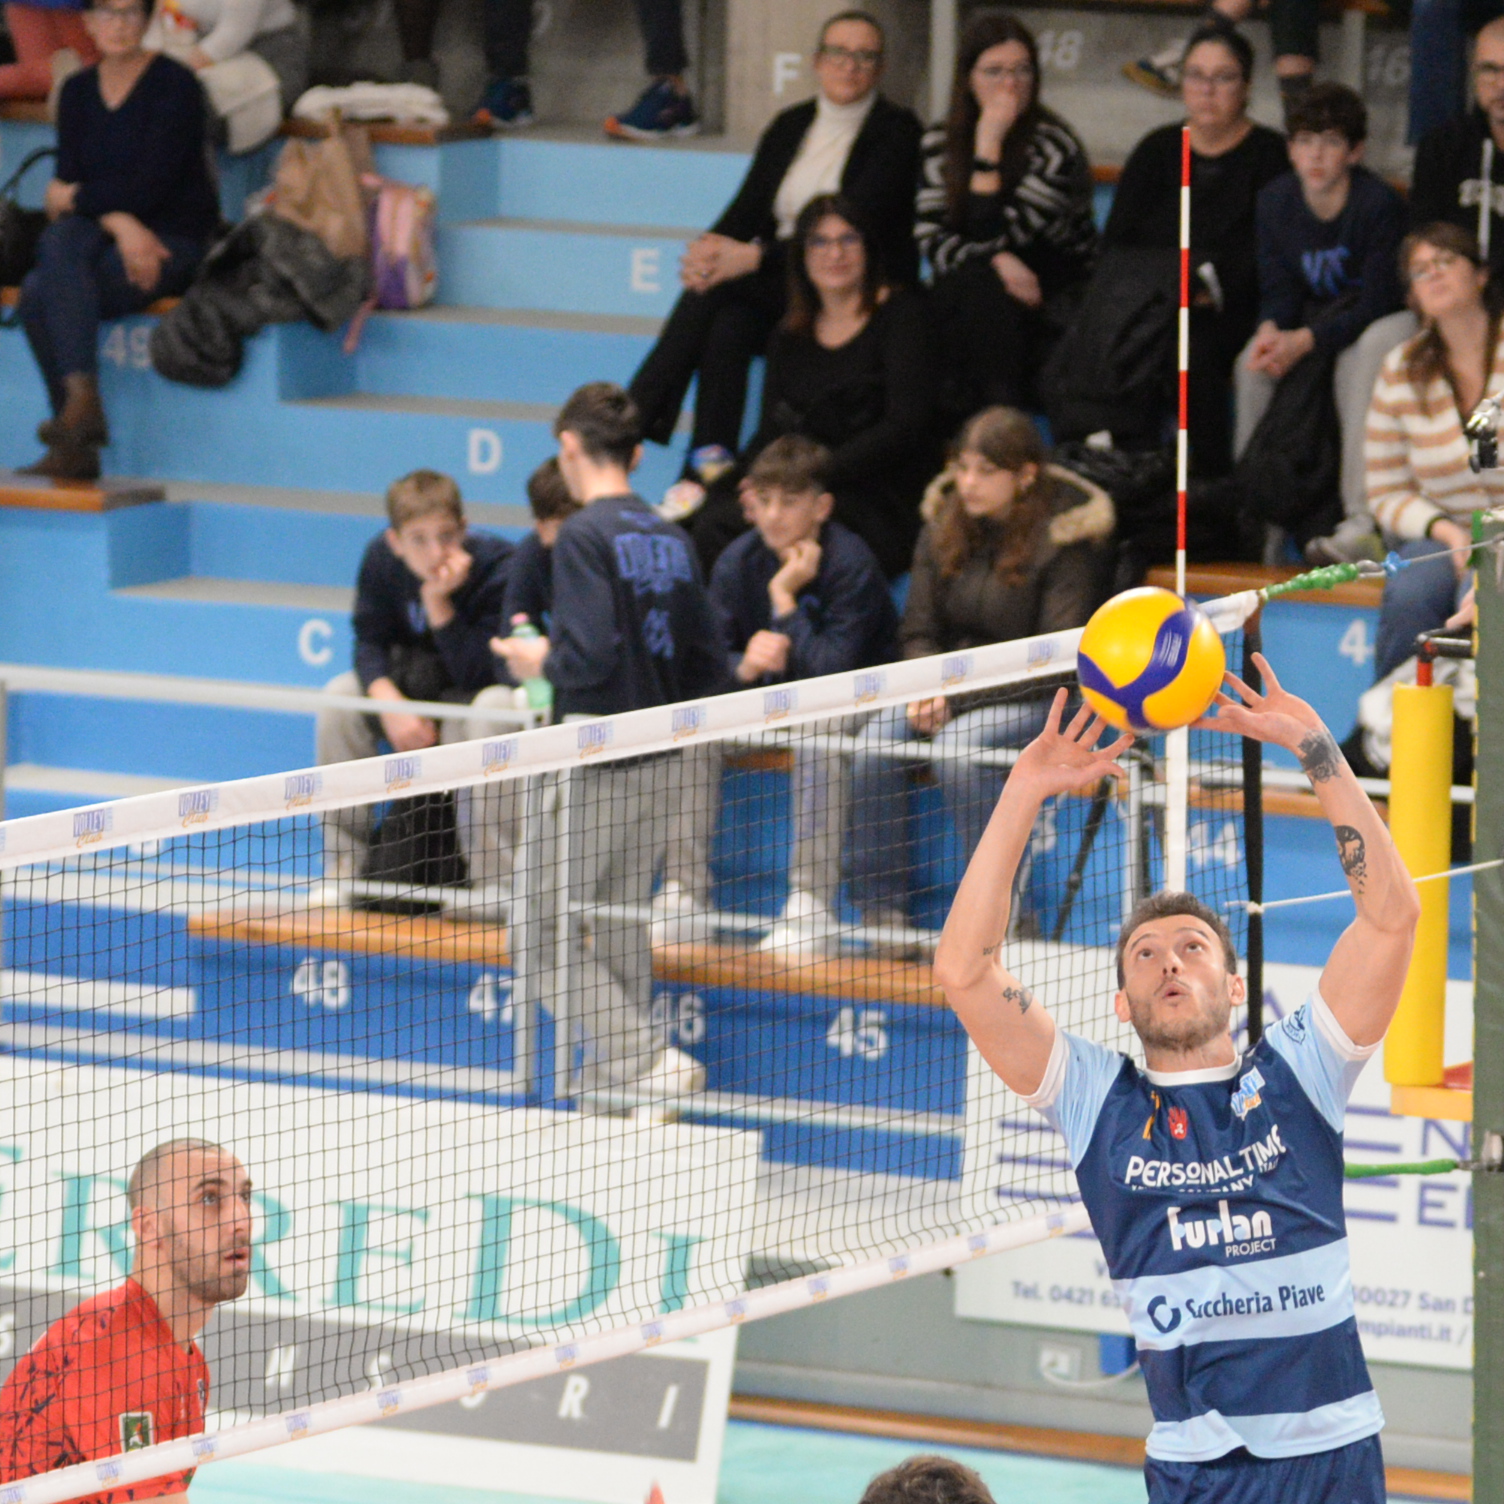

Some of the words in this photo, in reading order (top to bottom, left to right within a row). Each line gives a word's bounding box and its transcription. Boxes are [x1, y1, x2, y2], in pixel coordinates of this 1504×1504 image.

[772, 54, 800, 96] F
[632, 249, 660, 294] E
[467, 429, 502, 475] D
[298, 619, 333, 666] C
[290, 957, 349, 1008] 48
[826, 1005, 890, 1061] 45
[1124, 1154, 1245, 1188] PERSONAL
[1238, 1123, 1287, 1172] TIME
[1225, 1237, 1277, 1258] PROJECT
[1278, 1281, 1326, 1313] Piave
[1418, 1291, 1457, 1313] San
[1356, 1318, 1452, 1345] mpianti.it
